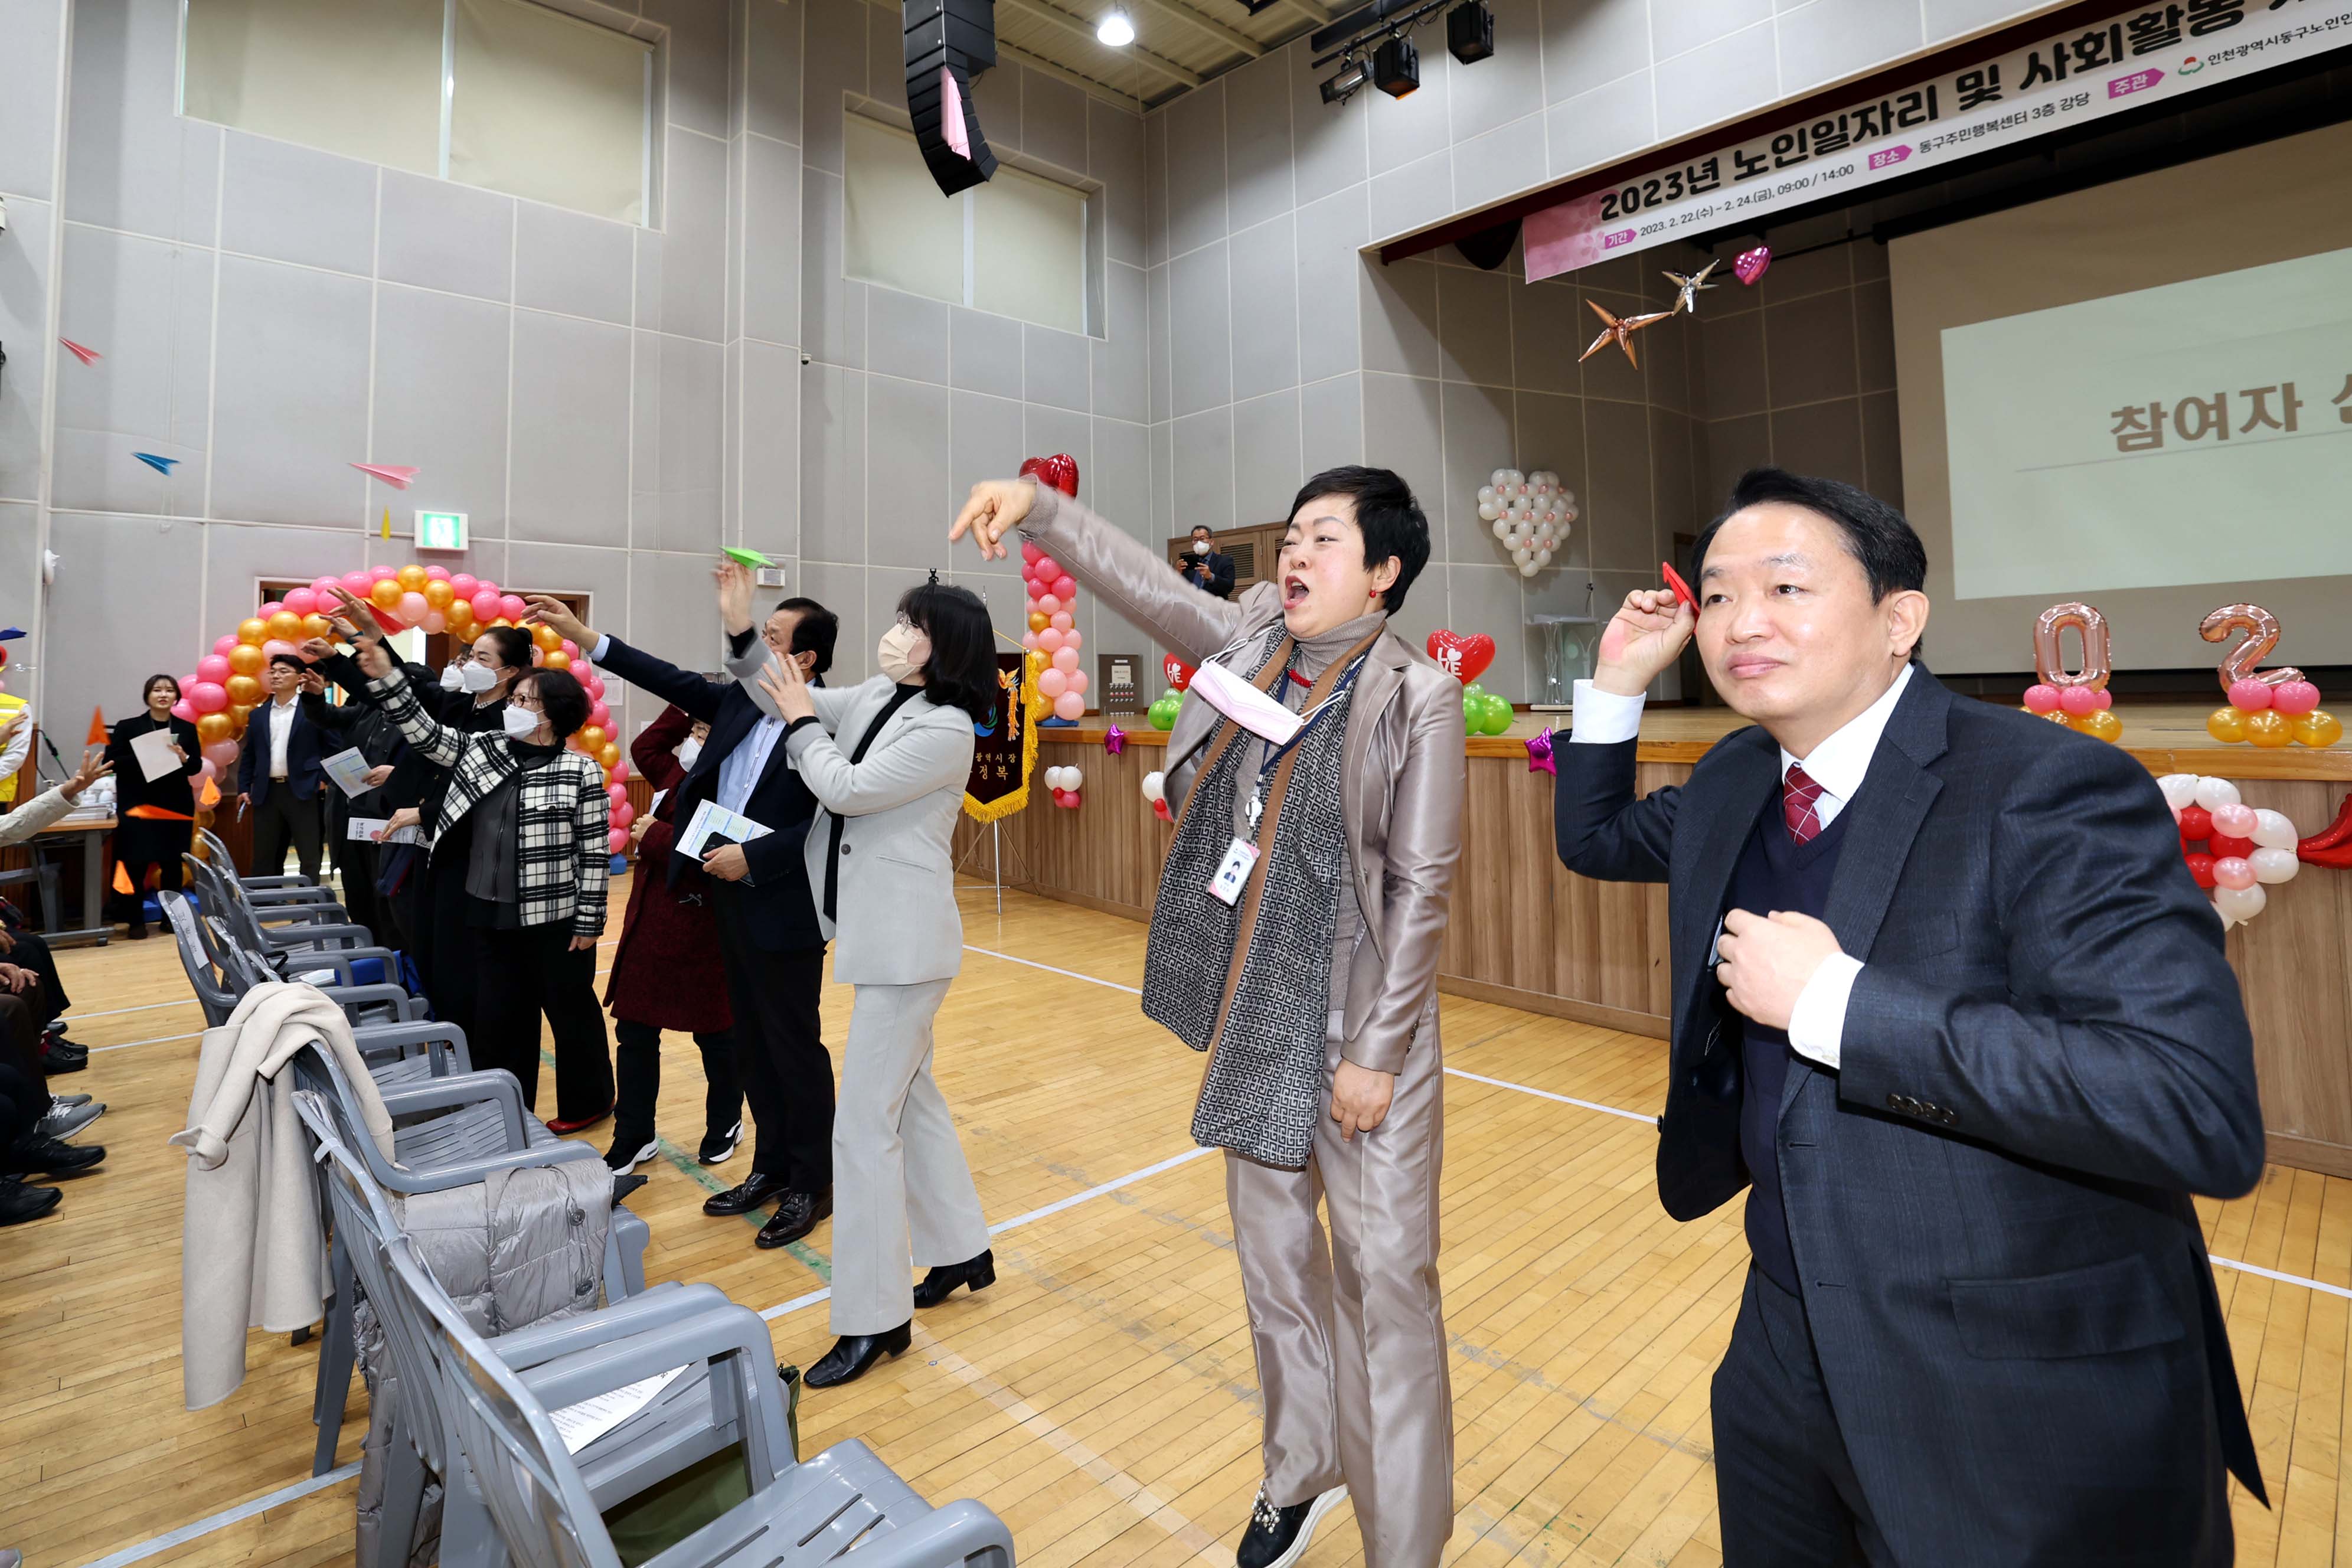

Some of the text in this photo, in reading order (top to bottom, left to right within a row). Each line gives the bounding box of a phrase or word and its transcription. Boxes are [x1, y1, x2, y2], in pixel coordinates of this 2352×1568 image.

[2114, 74, 2148, 95] 주관
[1600, 0, 2244, 221] 2023년 노인일자리 및 사회활동
[1919, 92, 2090, 153] 동구주민행복센터 3층 강당
[1873, 152, 1900, 167] 장소
[1640, 222, 1667, 236] 2023.
[1670, 218, 1678, 227] 2.
[1725, 201, 1734, 210] 2.
[1778, 178, 1809, 195] 09:00
[1812, 174, 1818, 187] /
[1821, 164, 1854, 181] 14:00
[1608, 232, 1628, 246] 기간
[2109, 382, 2304, 452] 참여자
[971, 765, 1008, 780] 정복
